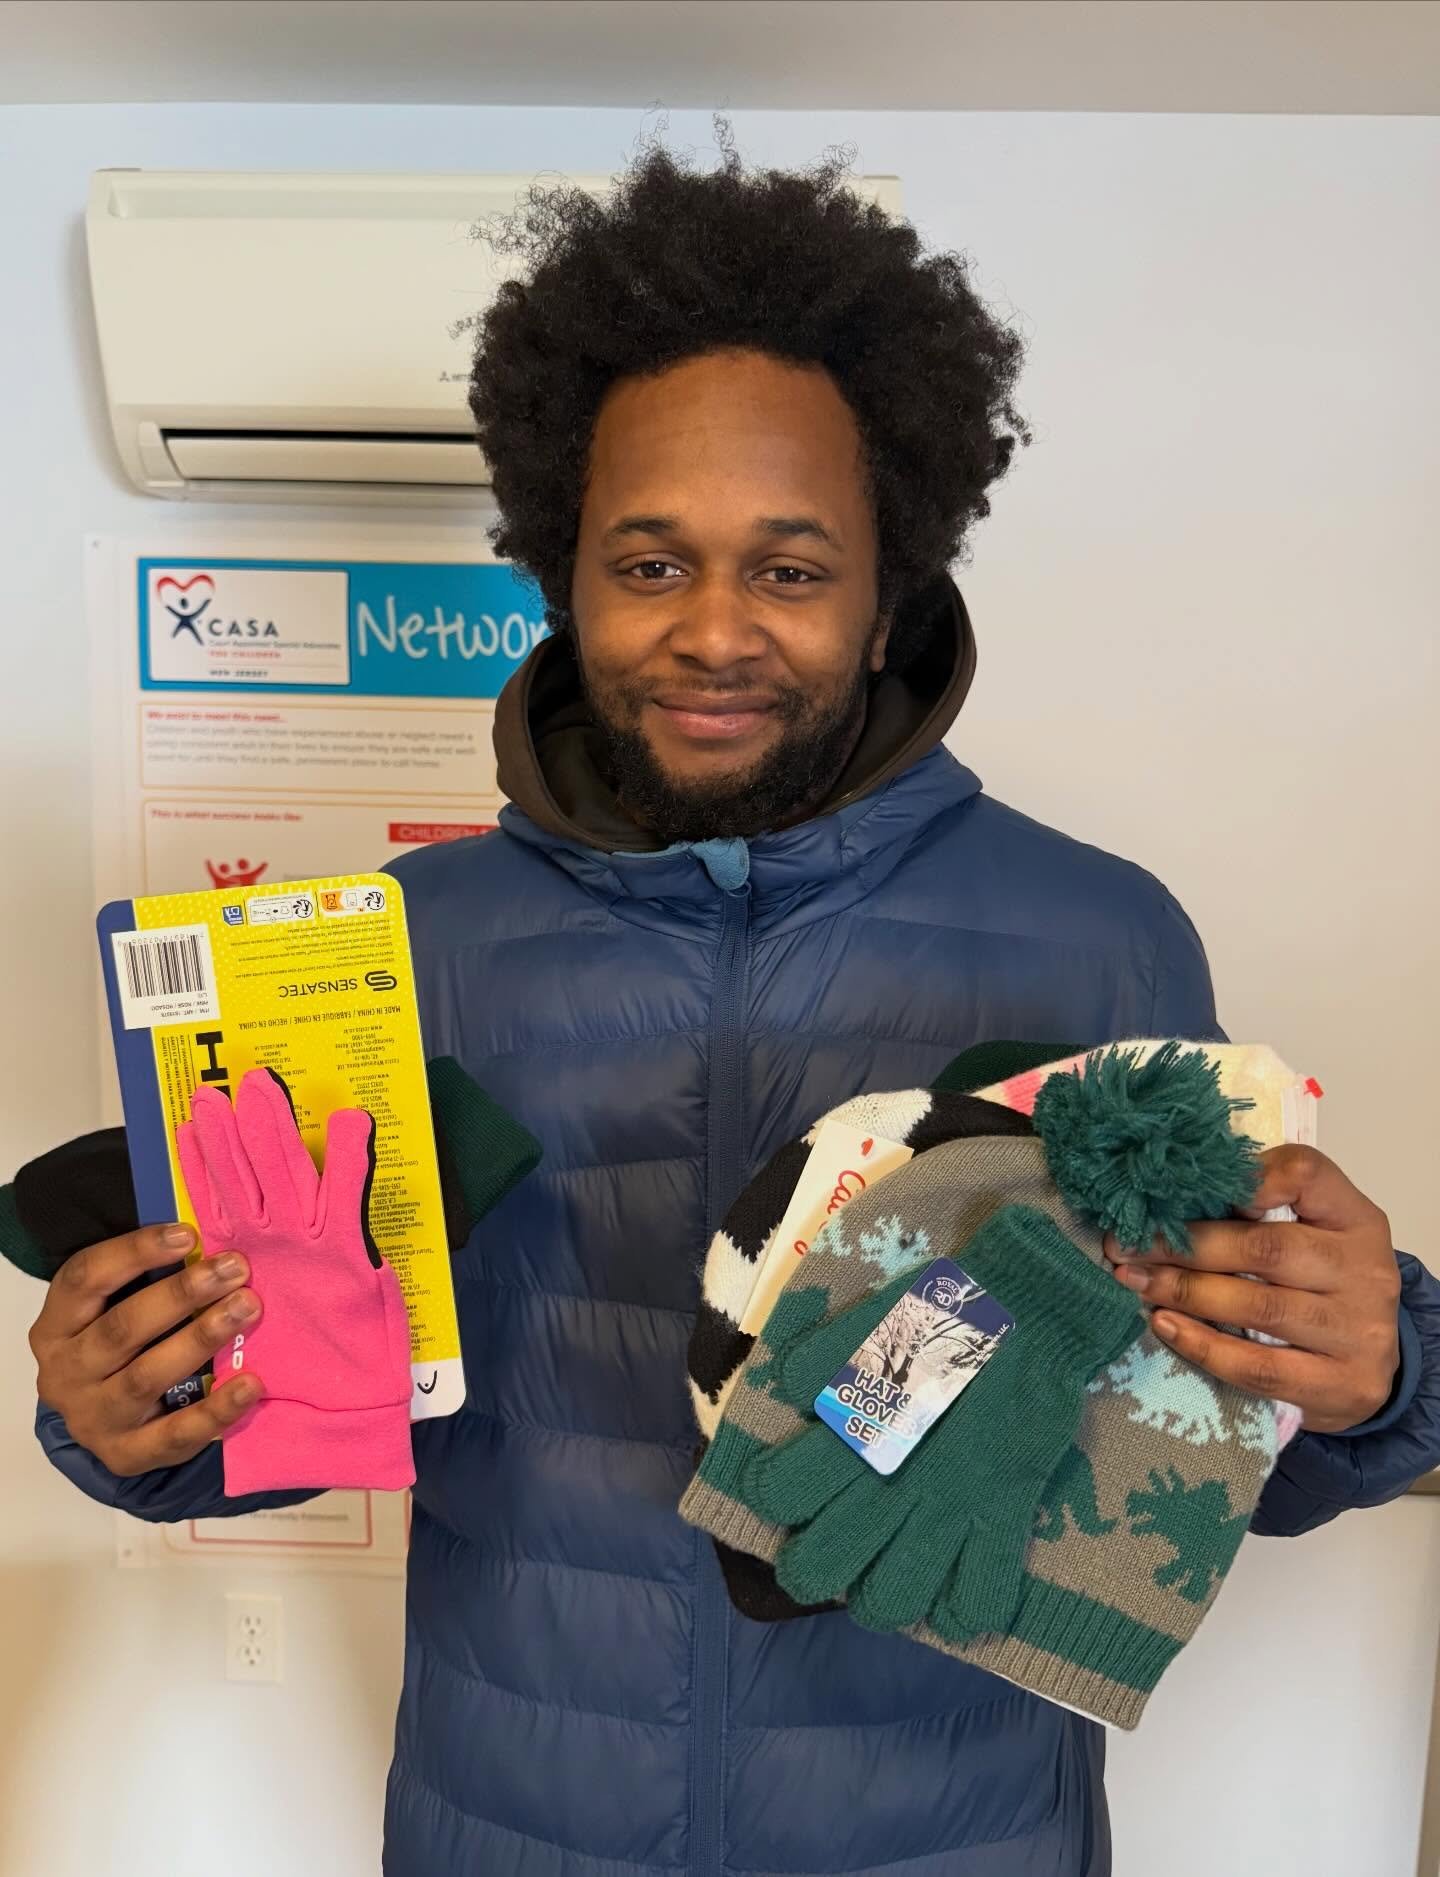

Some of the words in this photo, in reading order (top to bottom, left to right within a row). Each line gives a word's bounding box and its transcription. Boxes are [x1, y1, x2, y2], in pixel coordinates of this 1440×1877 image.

[208, 618, 280, 637] CASA
[277, 977, 357, 998] SENSATEC
[357, 1008, 375, 1016] CHINA
[383, 1005, 400, 1013] MADE
[267, 1017, 287, 1026] HECHO
[293, 1014, 311, 1024] CHINE
[238, 1021, 257, 1030] CHINA
[937, 1278, 960, 1296] ROYAL
[855, 1367, 902, 1401] HAT
[895, 1390, 913, 1410] &
[176, 1394, 189, 1406] G
[845, 1415, 886, 1448] SET
